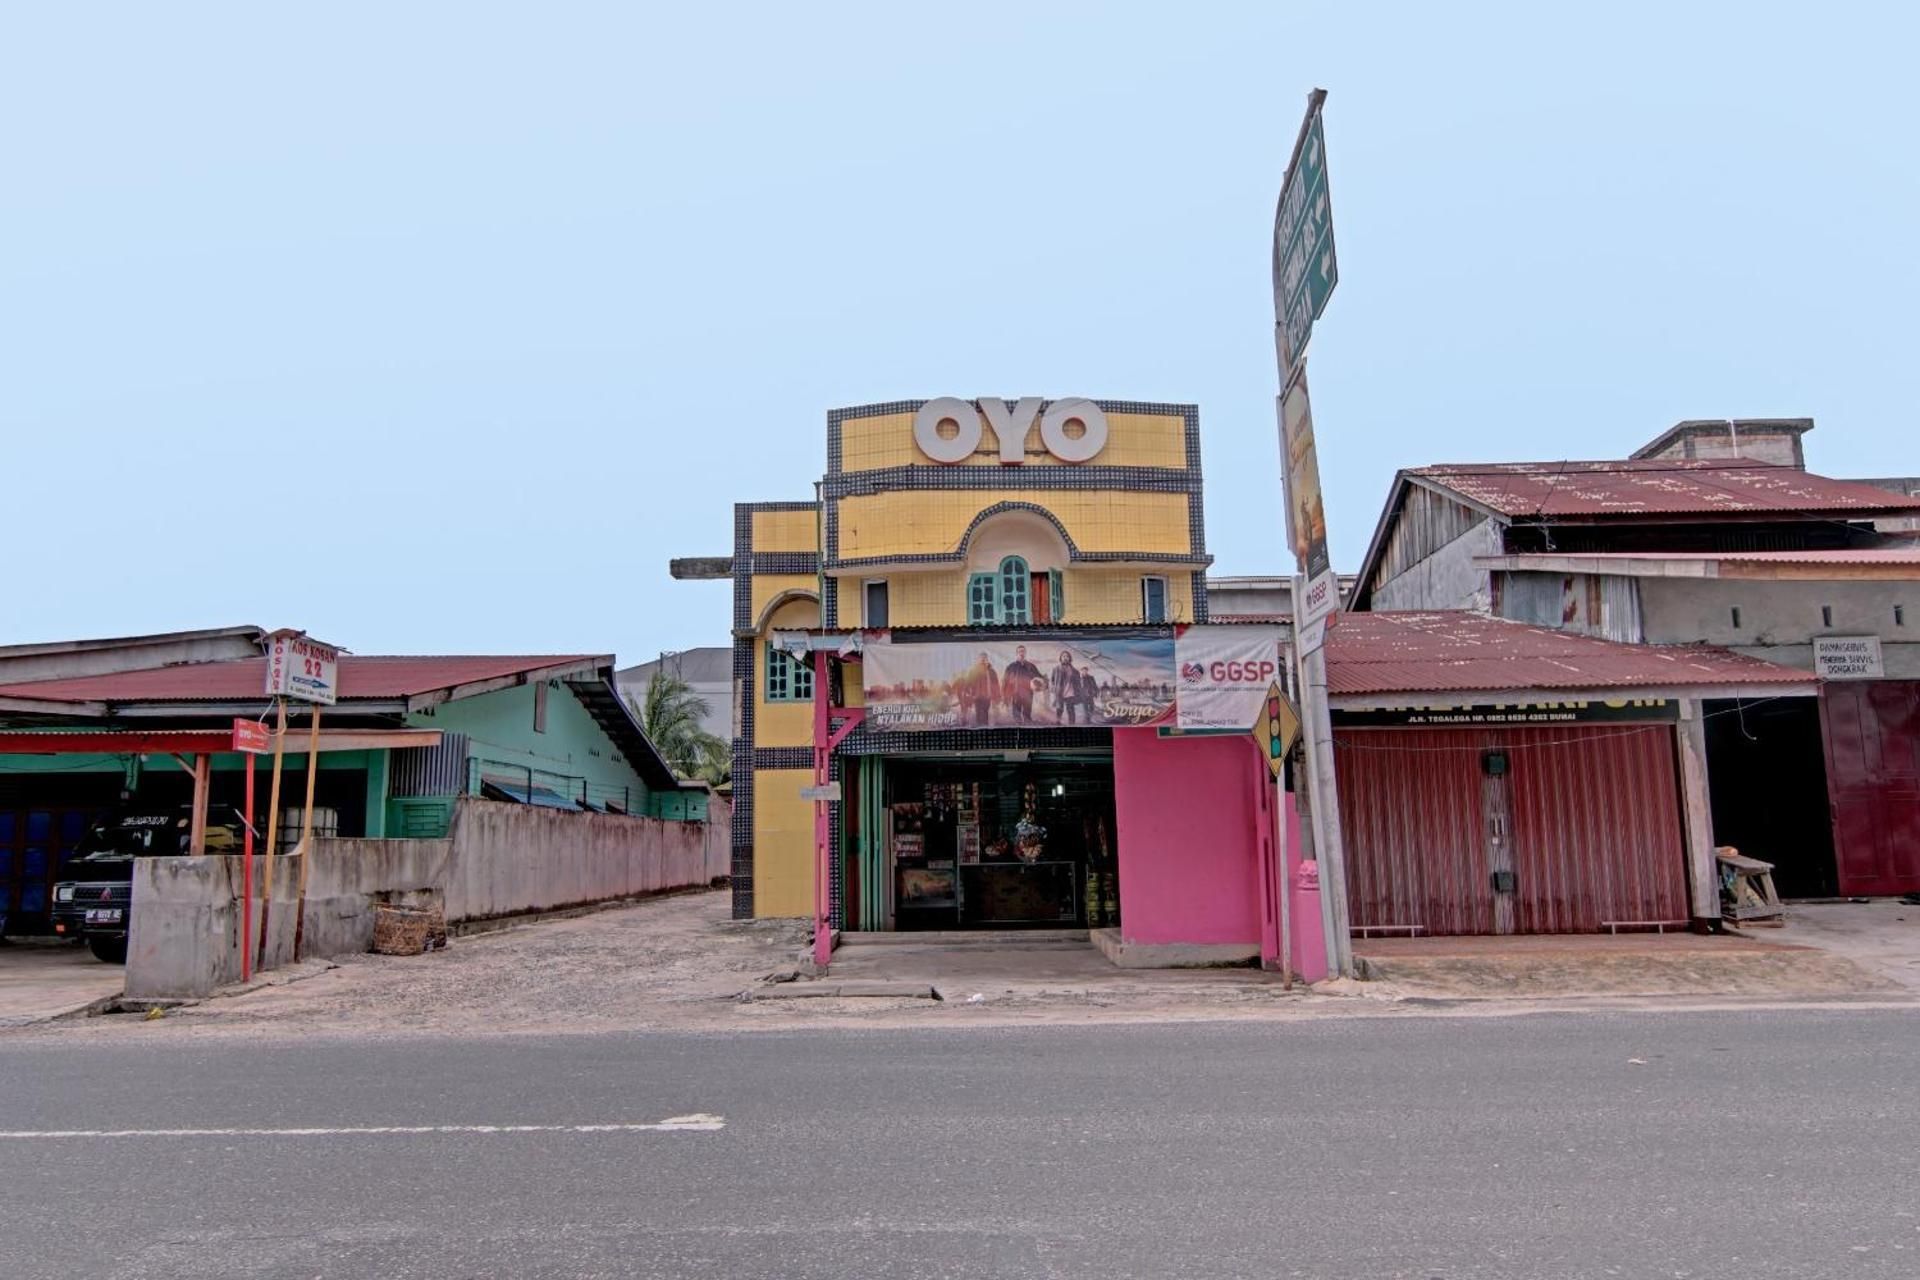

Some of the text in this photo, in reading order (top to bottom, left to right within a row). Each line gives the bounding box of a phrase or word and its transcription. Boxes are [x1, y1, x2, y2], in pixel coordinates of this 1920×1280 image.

[913, 396, 1109, 466] OYO
[292, 640, 336, 664] KOS KOSAN
[305, 658, 322, 677] 22
[1210, 661, 1275, 682] GGSP
[876, 713, 925, 725] NYALAKAN
[1428, 715, 1470, 723] TEGALEGA
